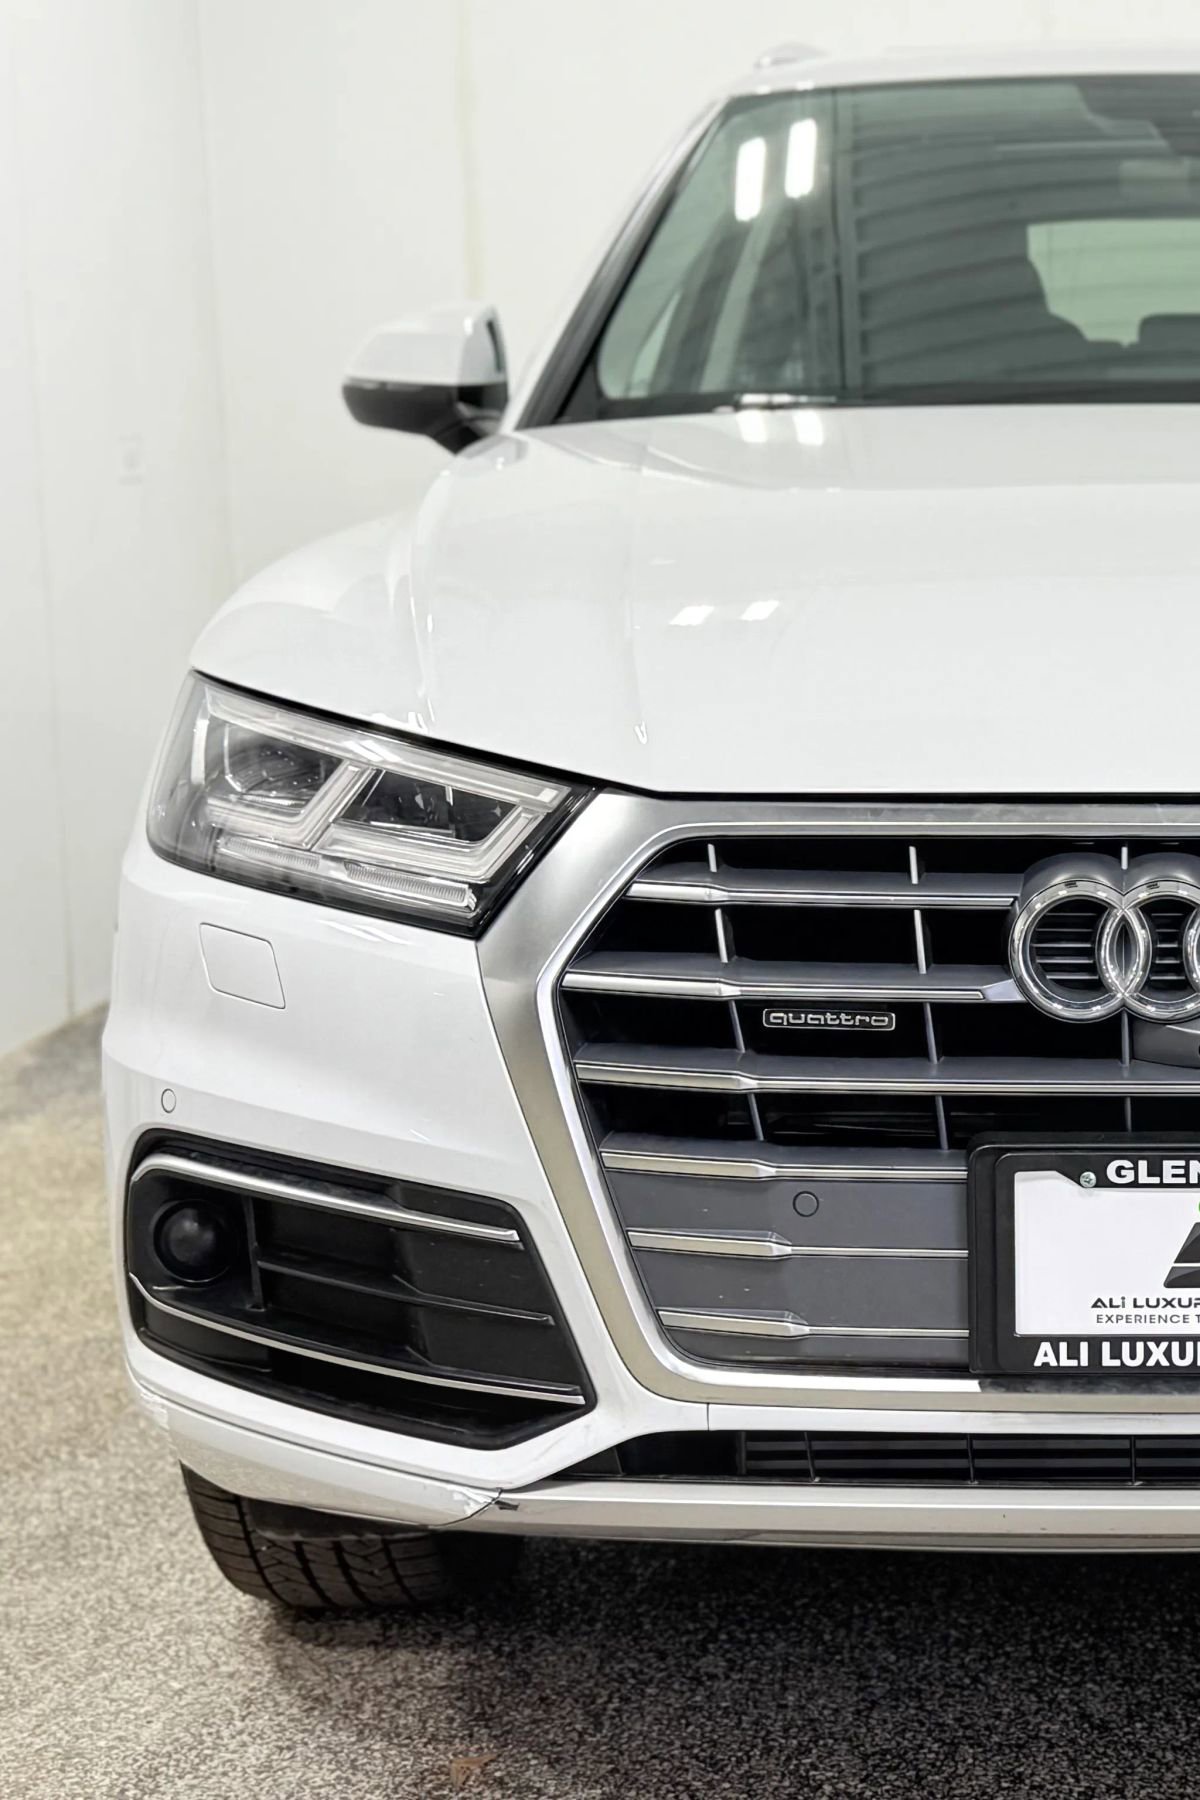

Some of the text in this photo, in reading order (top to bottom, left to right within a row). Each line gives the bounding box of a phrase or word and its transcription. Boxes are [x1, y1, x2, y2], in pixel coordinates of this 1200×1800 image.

[769, 1012, 889, 1026] quattro
[1096, 1314, 1190, 1324] EXPERIENCE
[1033, 1341, 1089, 1367] ALI
